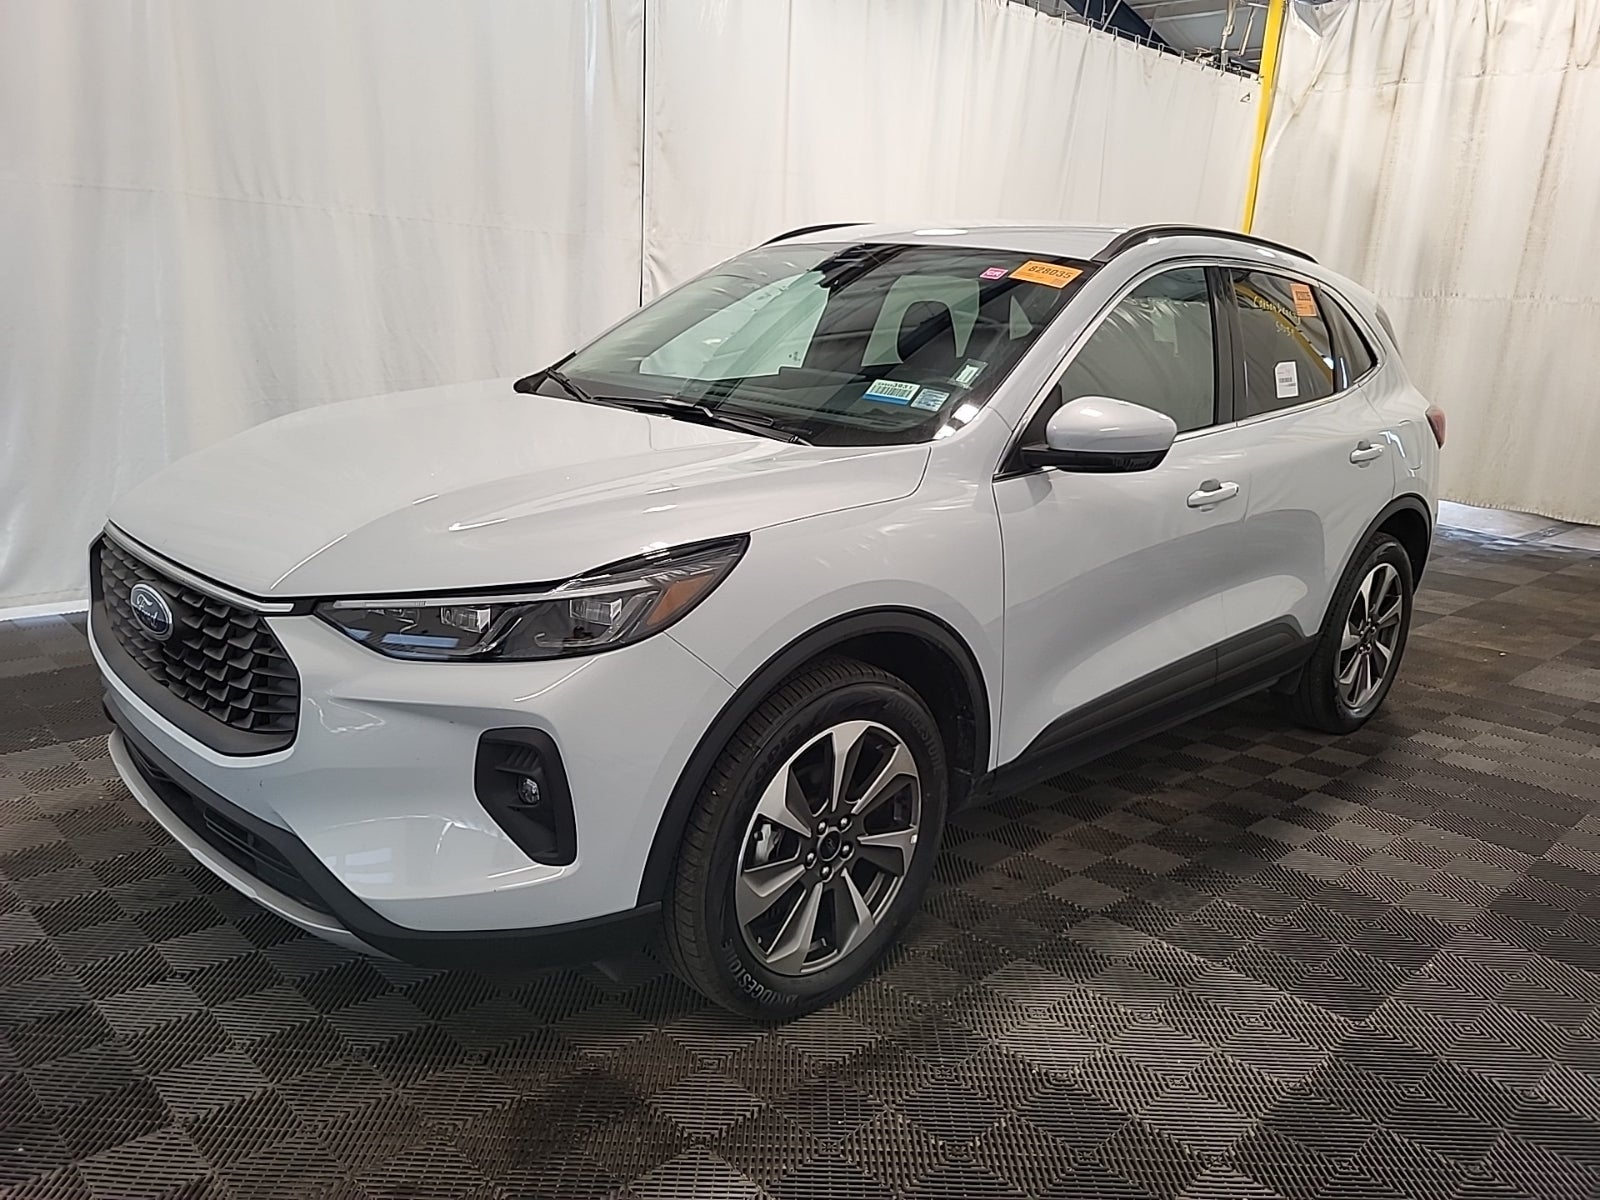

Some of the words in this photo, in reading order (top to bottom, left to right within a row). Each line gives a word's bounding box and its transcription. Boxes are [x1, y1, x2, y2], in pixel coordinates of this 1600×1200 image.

[1028, 265, 1073, 279] 828035
[136, 593, 159, 628] Ford
[721, 938, 799, 1007] BRIDGESTONE
